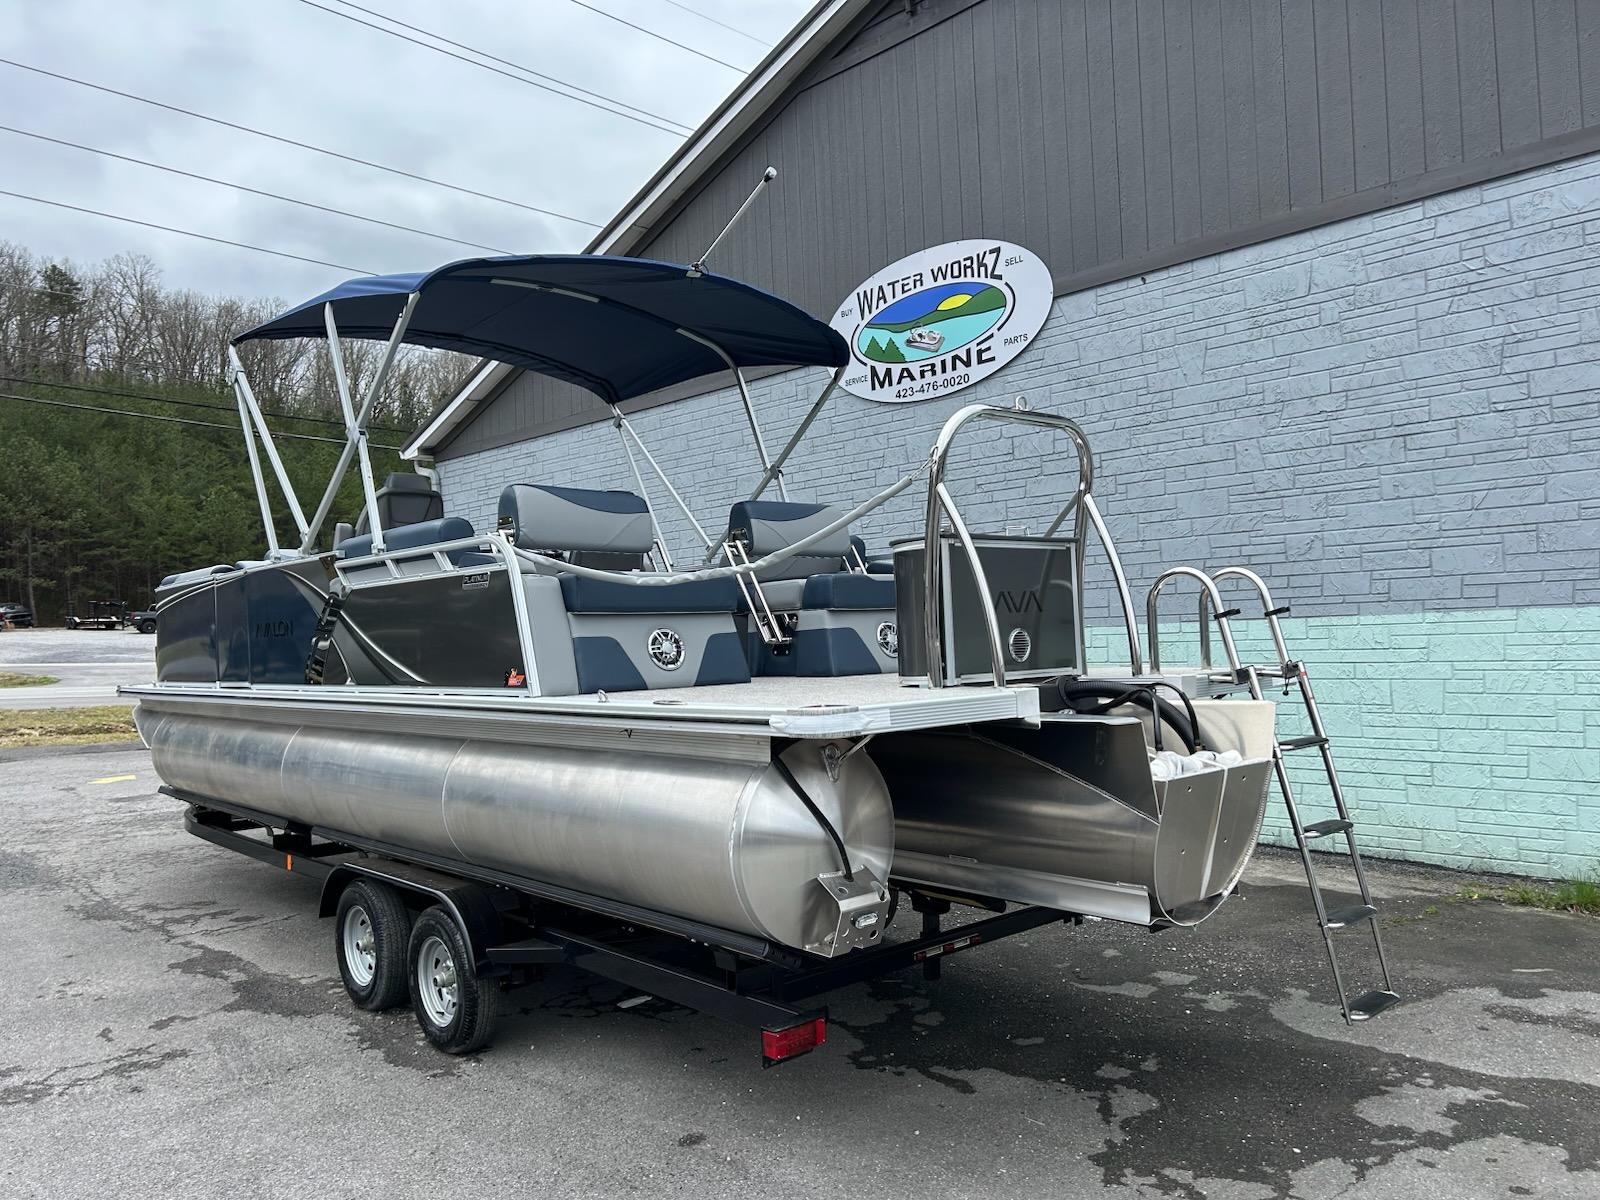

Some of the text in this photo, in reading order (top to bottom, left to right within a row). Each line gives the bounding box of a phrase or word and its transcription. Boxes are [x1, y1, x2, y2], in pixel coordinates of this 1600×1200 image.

[1004, 255, 1024, 267] SELL
[857, 246, 1003, 321] WATER WORKZ
[841, 307, 854, 318] BUY
[1003, 333, 1029, 347] PARTS
[870, 333, 996, 391] MARINE
[845, 374, 869, 387] SERVICE
[895, 373, 970, 399] 423-476-0020
